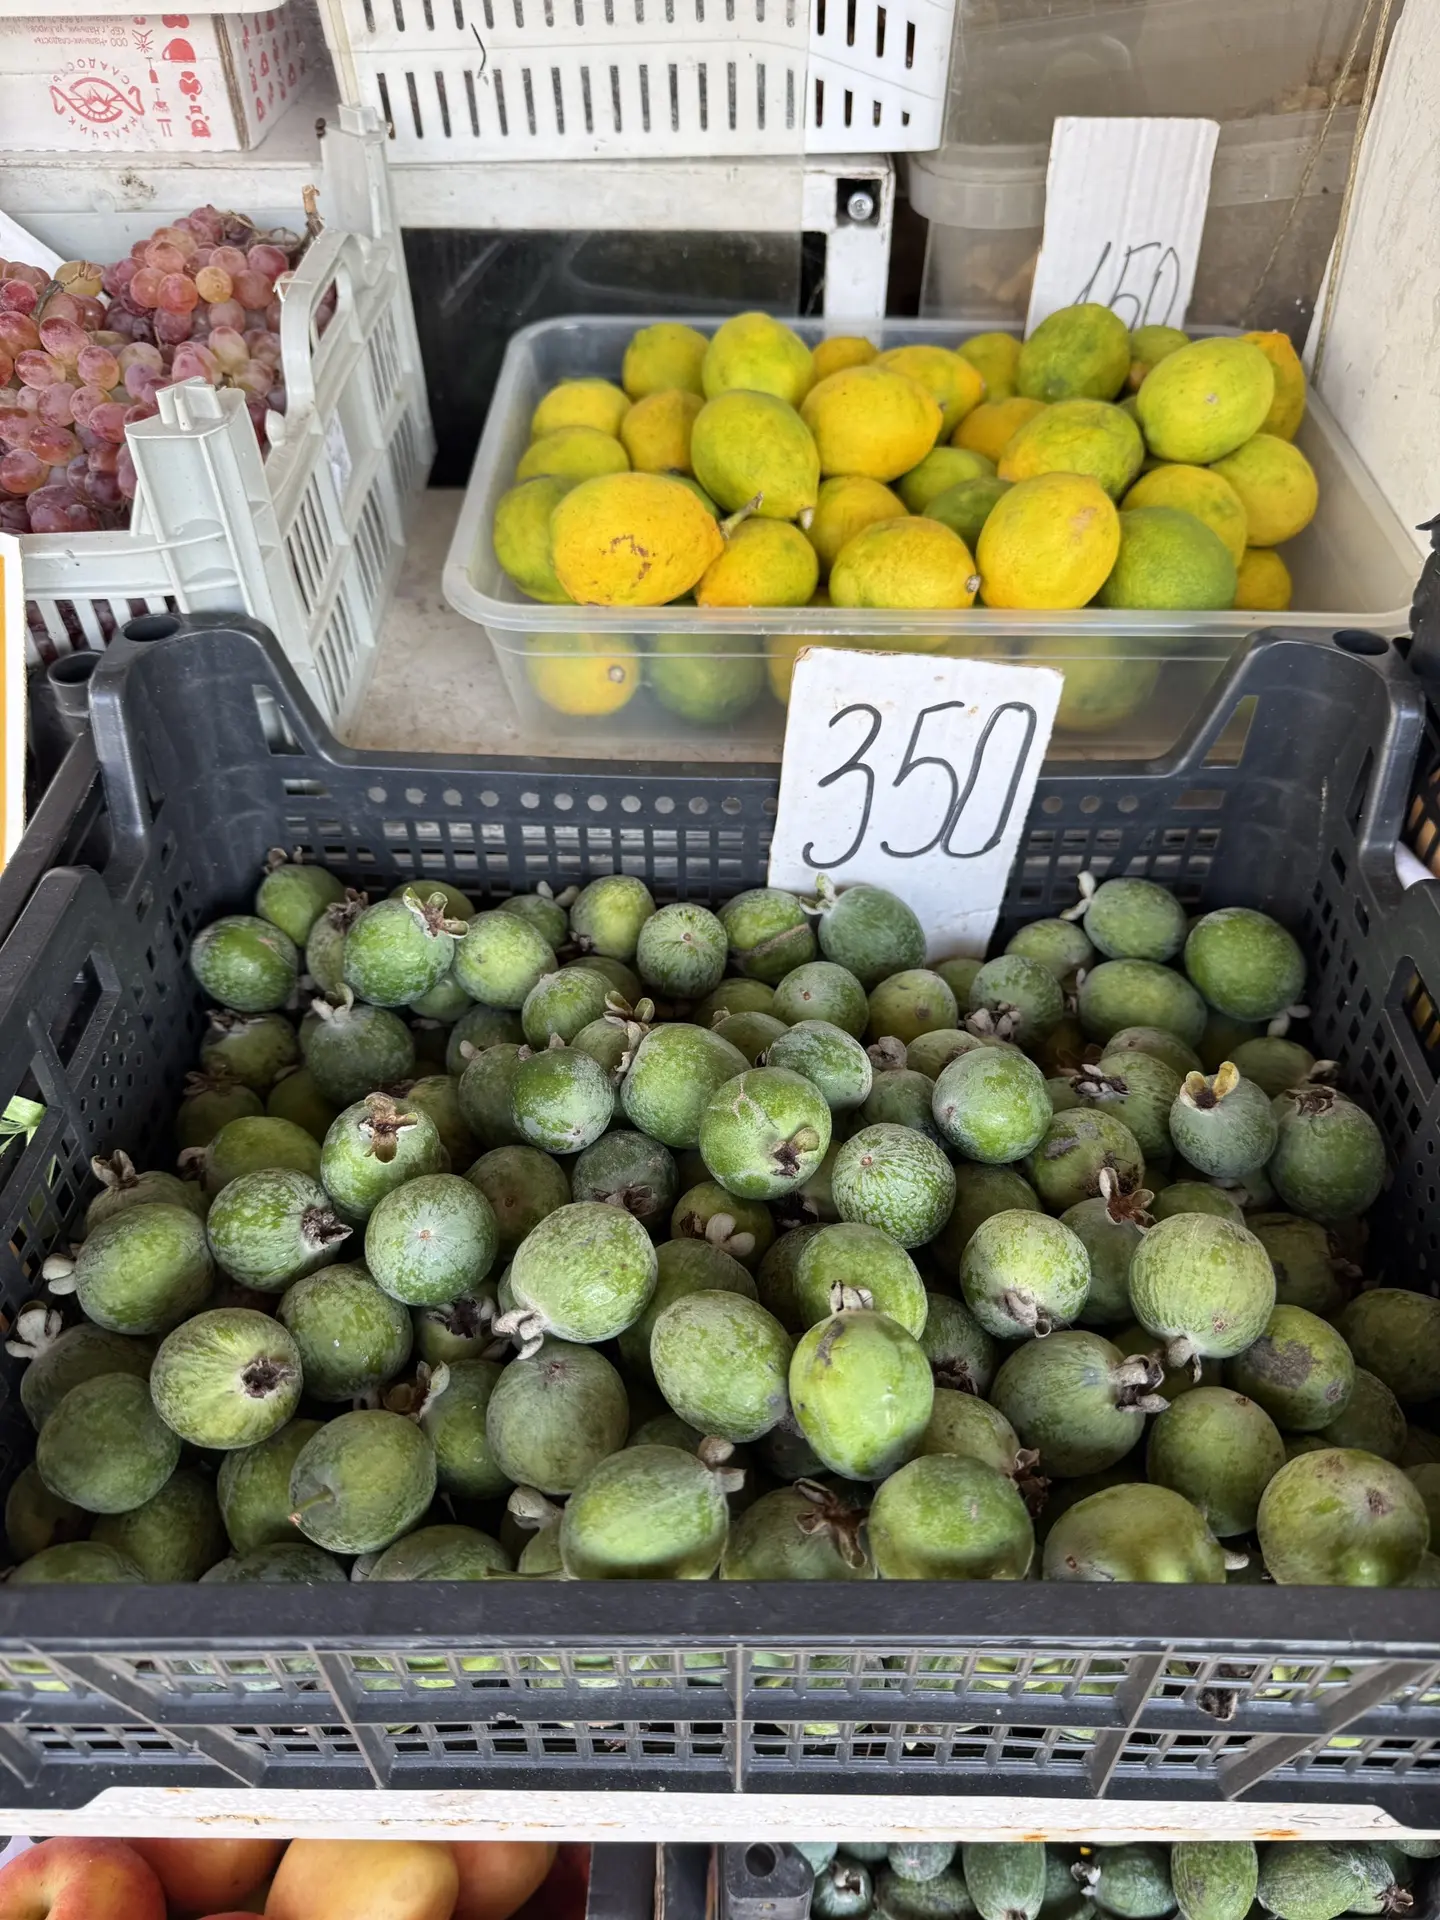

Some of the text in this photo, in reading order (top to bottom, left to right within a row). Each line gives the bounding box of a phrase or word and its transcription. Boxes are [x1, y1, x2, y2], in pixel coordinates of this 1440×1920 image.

[110, 37, 128, 47] ООО
[52, 57, 130, 84] СЛАДОСТЬ
[68, 115, 138, 139] НАЛЬЧИК
[802, 700, 1037, 869] 350
